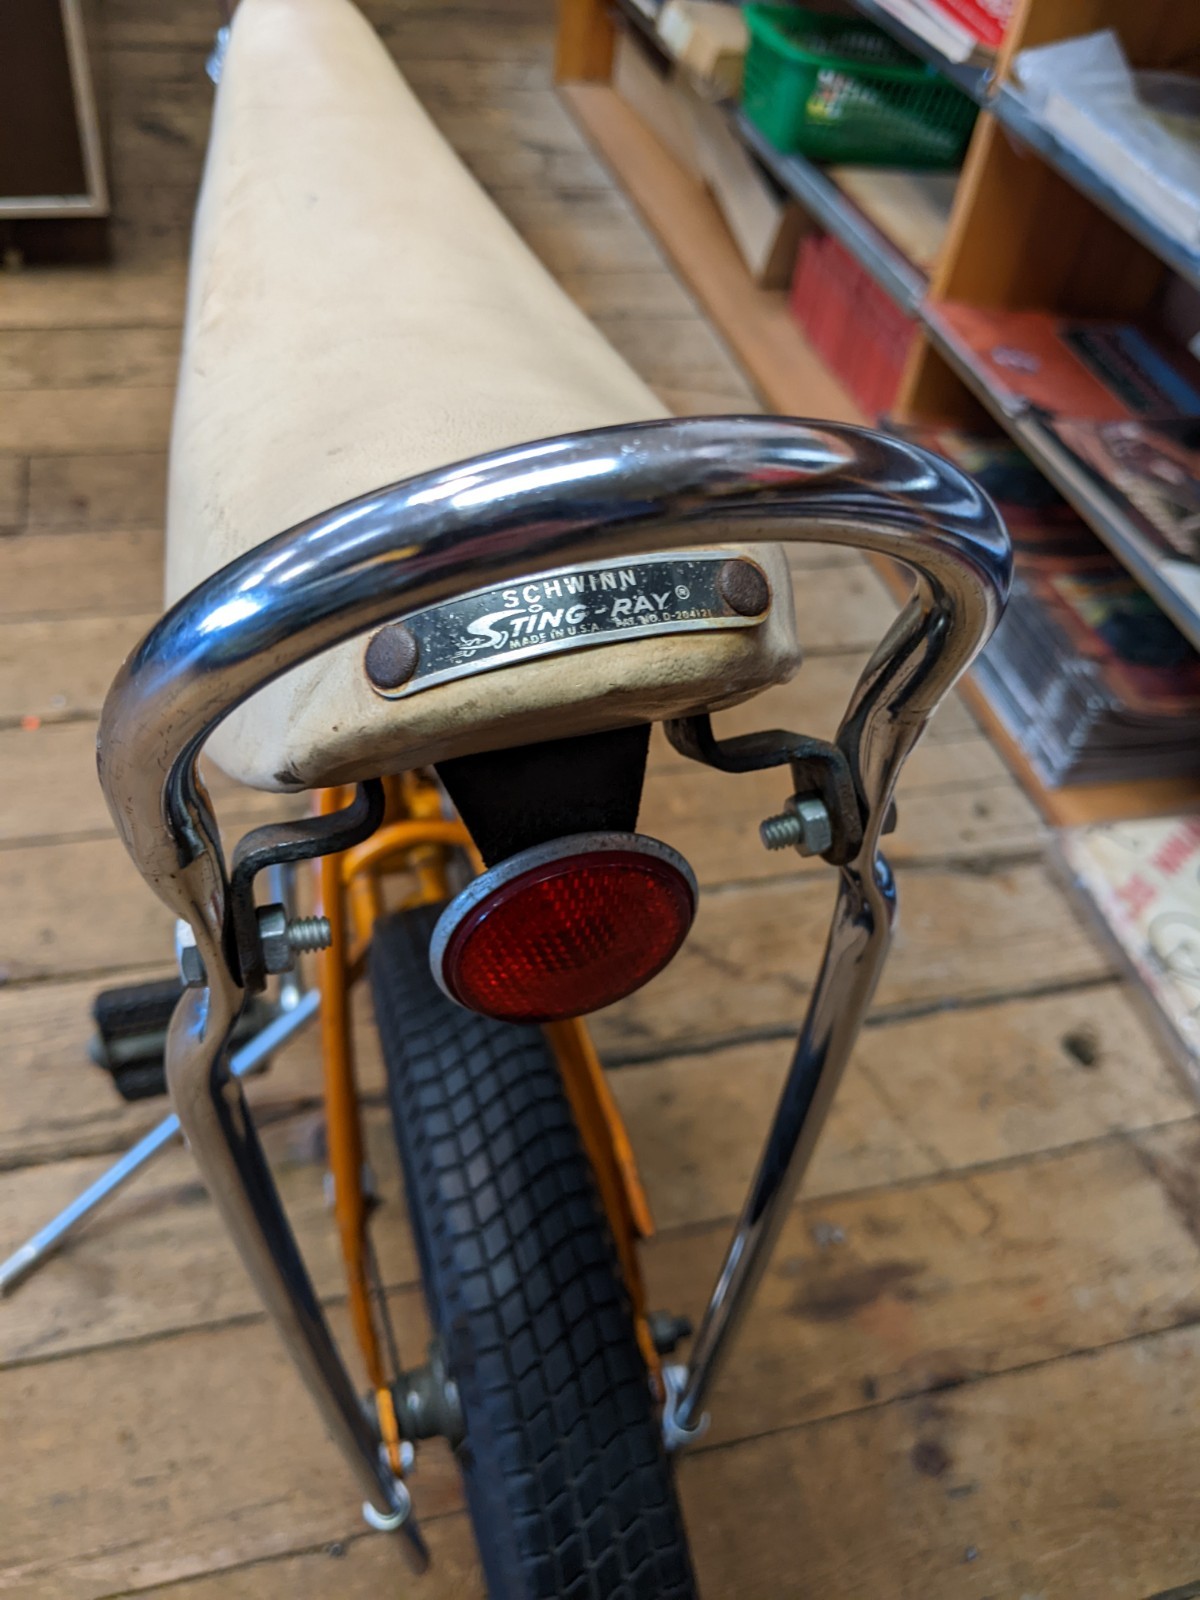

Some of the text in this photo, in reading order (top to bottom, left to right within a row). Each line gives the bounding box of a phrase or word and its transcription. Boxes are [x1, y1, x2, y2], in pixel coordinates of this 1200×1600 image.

[502, 570, 637, 608] SCHWINN
[509, 633, 547, 649] MADE
[550, 628, 564, 639] IN
[615, 617, 638, 628] PAT.
[640, 614, 661, 625] NO.
